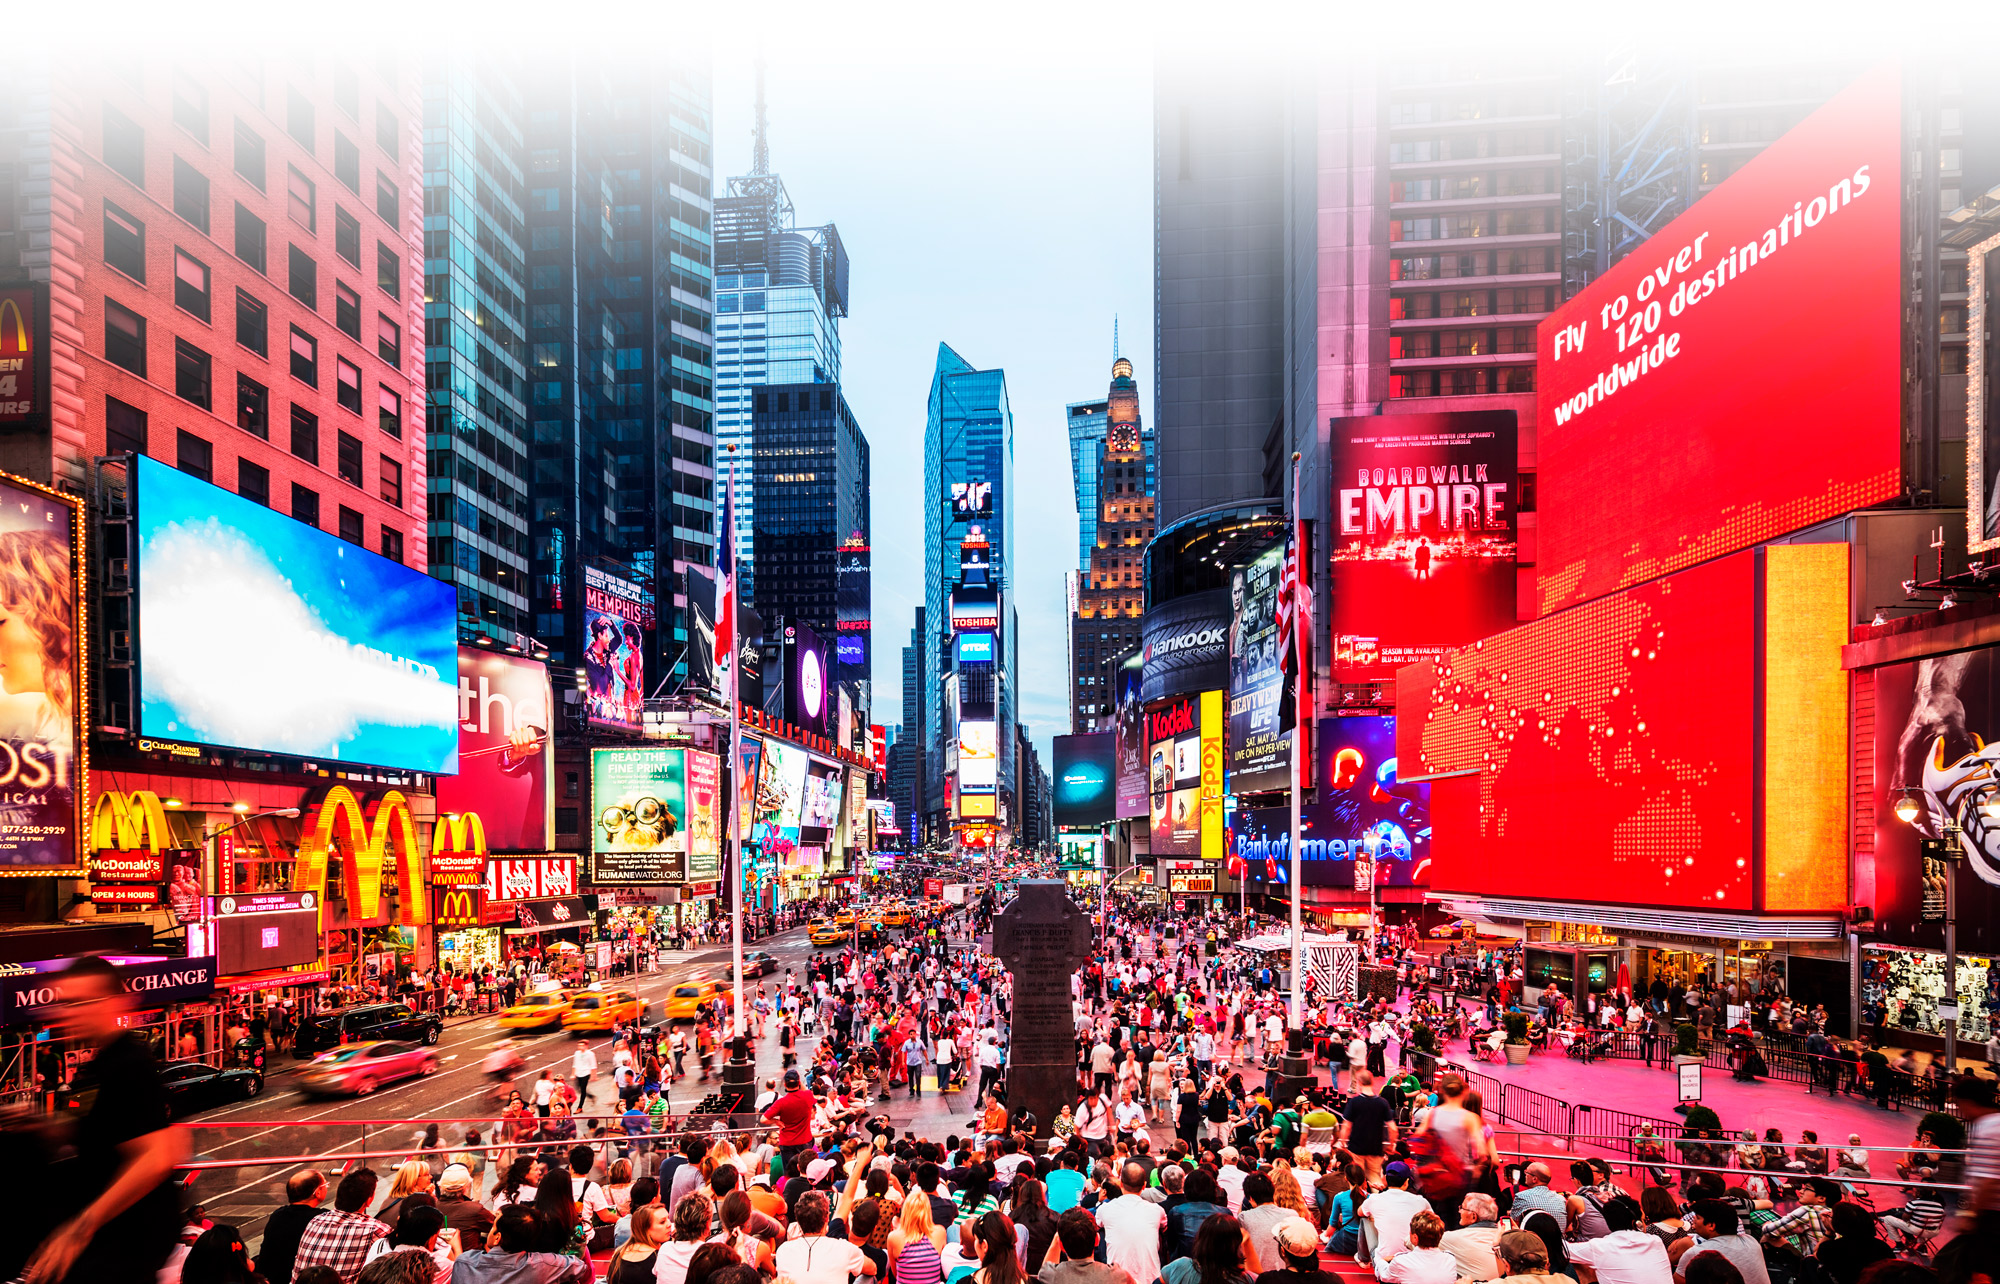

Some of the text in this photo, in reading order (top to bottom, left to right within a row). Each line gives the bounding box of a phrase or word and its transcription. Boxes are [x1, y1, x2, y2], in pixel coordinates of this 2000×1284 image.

[1615, 165, 1871, 352] 120 destinations
[1554, 231, 1708, 361] Fly to over
[1554, 332, 1681, 426] worldwide
[1358, 464, 1488, 487] BOARDWALK
[1340, 482, 1507, 536] EMPIRE
[586, 574, 606, 590] BEST
[608, 582, 642, 602] MUSICAL
[586, 587, 642, 622] MEMPHIS
[954, 618, 997, 628] TOSHIBA
[968, 643, 990, 652] TDK
[1159, 643, 1225, 662] driving emotion
[1382, 648, 1402, 656] SEASON
[1415, 646, 1444, 654] AVAILABLE
[458, 676, 546, 736] the
[1231, 682, 1283, 716] HEAVYWEIG
[1152, 699, 1194, 742] Kodak
[1250, 706, 1272, 729] UFC
[1234, 750, 1246, 761] LIVE
[1246, 748, 1254, 758] ON
[1256, 738, 1292, 757] PAY-PER-VIEW
[1246, 730, 1278, 748] SAT. MAY 26
[608, 763, 670, 773] FINE PRINT
[610, 752, 666, 762] READ THE
[1203, 736, 1220, 816] Kodak
[2, 825, 66, 835] 877-250-2929
[1238, 831, 1412, 861] Bank of merica
[90, 859, 160, 871] McDonald's
[432, 856, 482, 866] McDonald's
[1188, 880, 1212, 890] EVITA
[1604, 928, 1712, 944] AMERICAN EAGLE OUTFITTERS
[122, 968, 208, 994] XCHANGE
[15, 987, 65, 1008] MON
